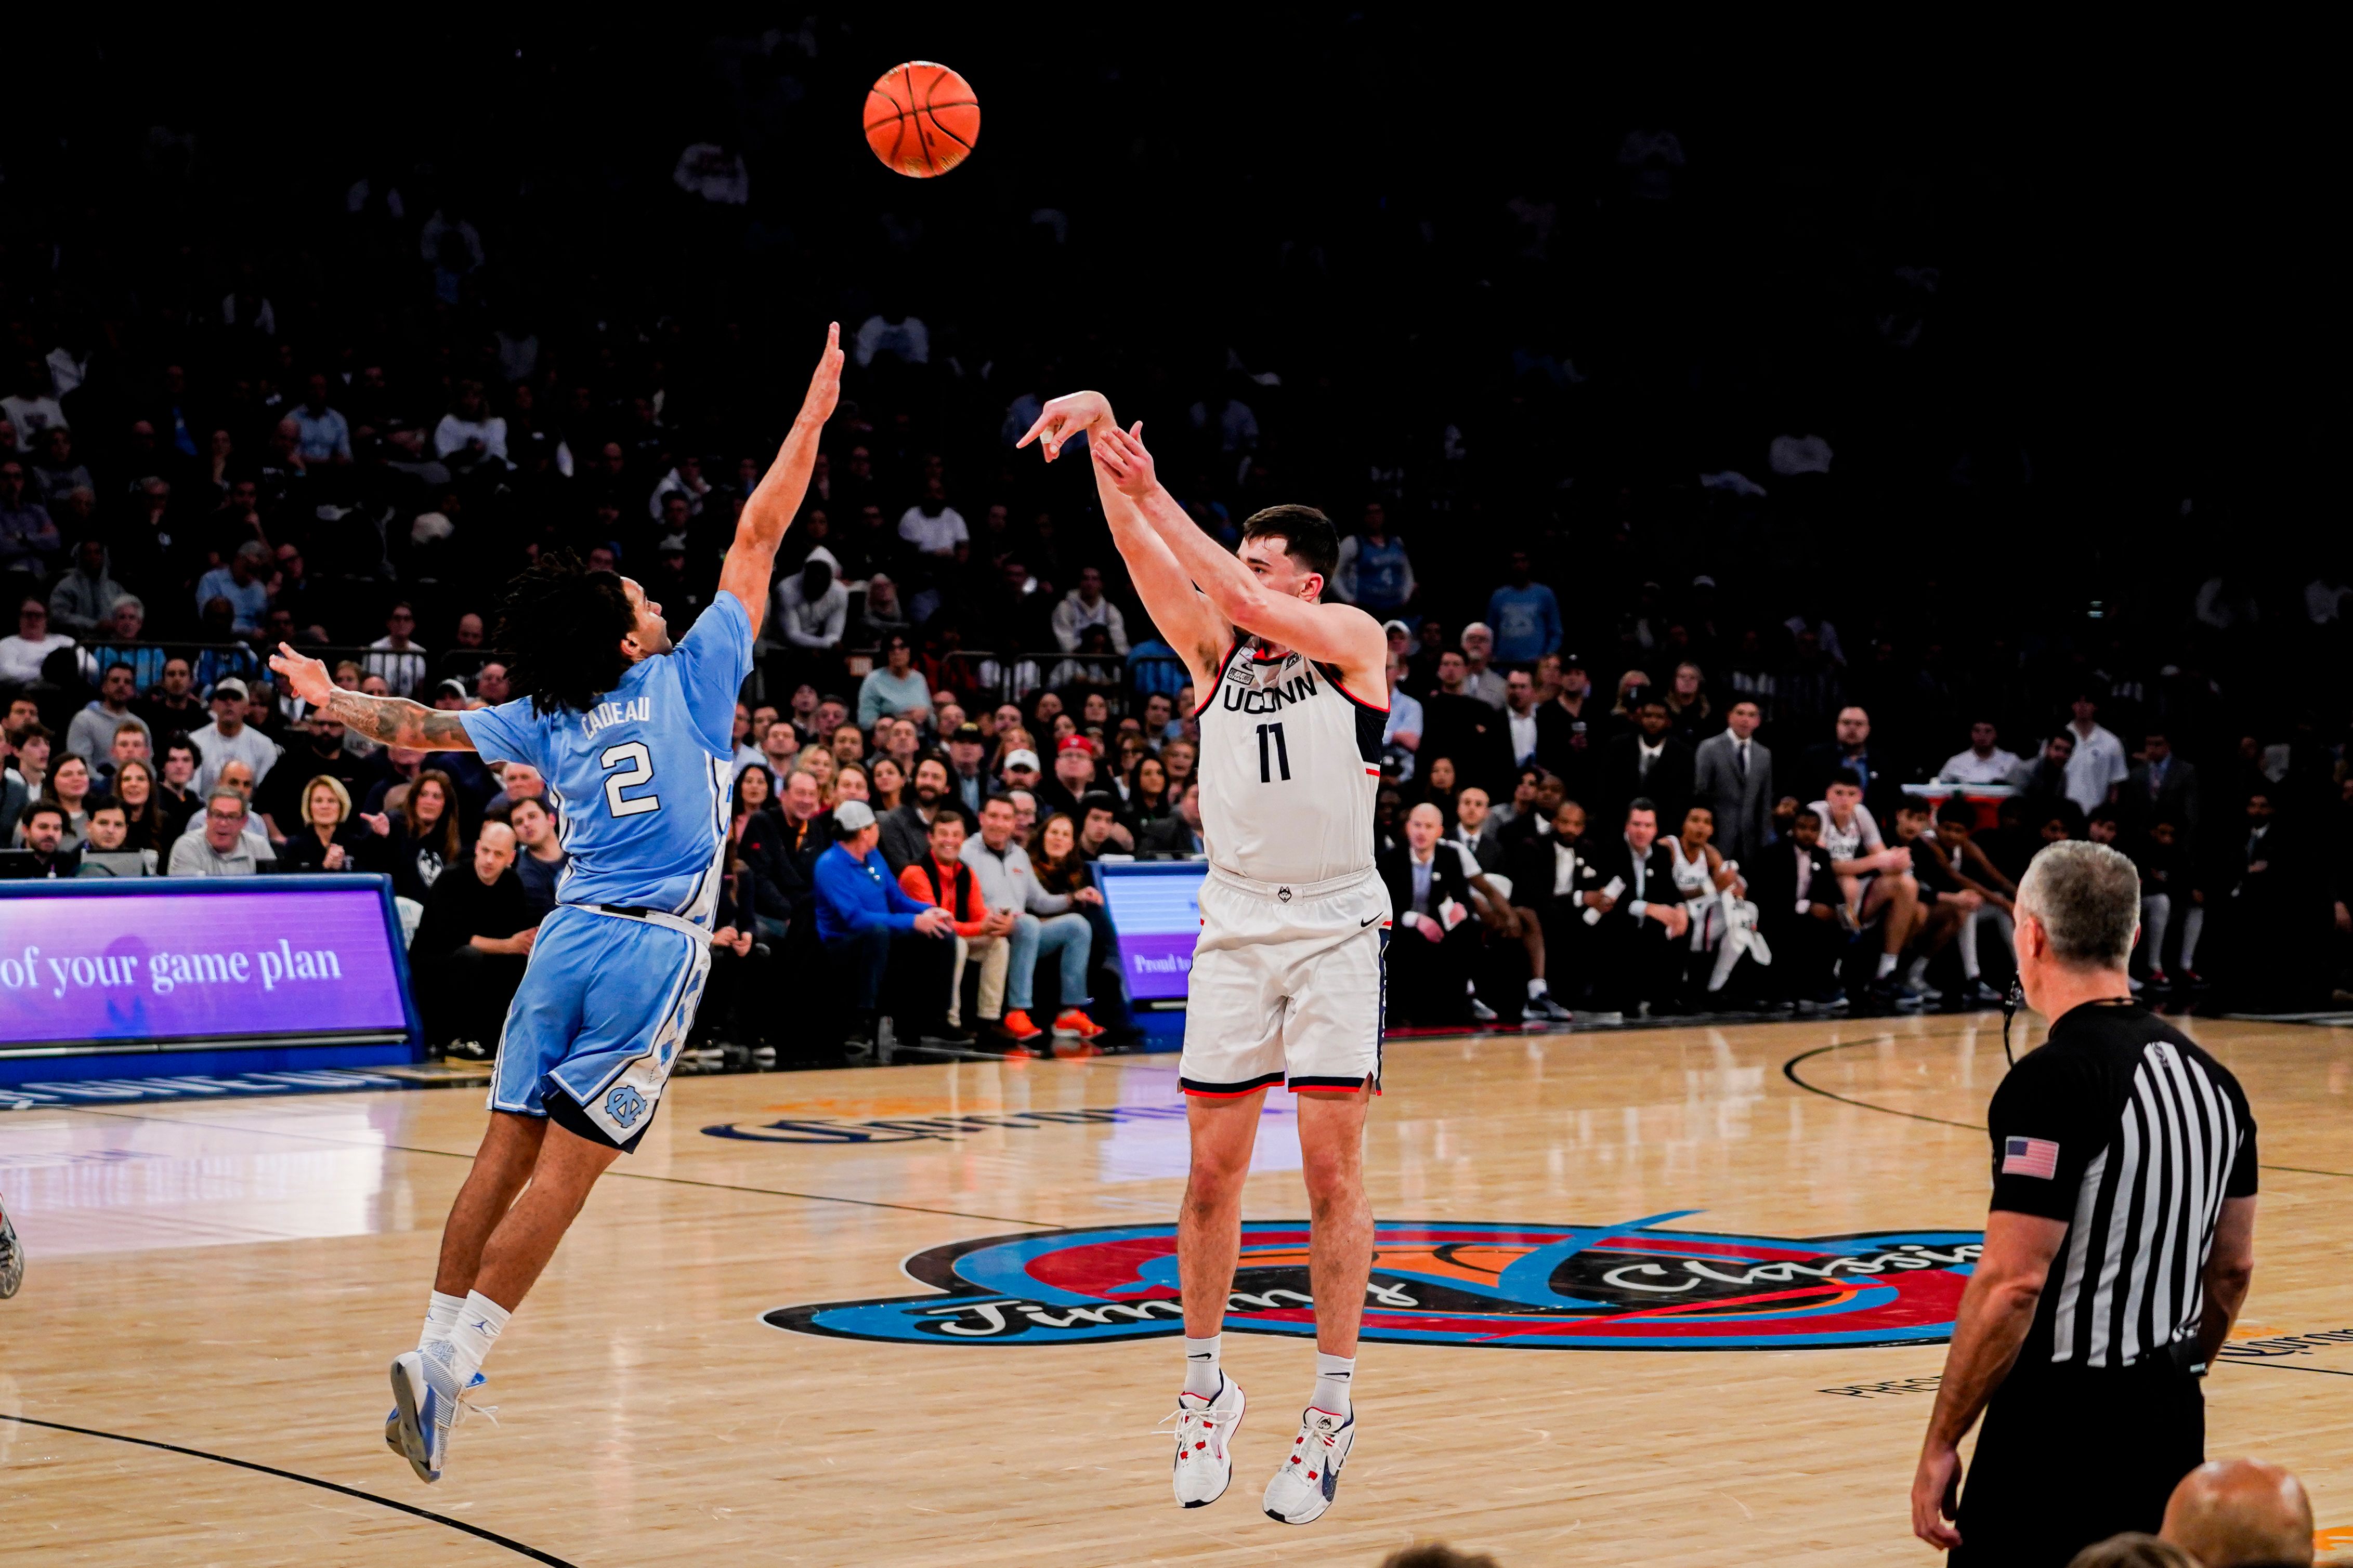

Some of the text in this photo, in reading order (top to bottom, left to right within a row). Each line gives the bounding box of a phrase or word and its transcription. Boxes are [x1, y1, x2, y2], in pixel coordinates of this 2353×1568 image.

[581, 696, 650, 741] CADEAU
[1224, 671, 1318, 714] UCONN
[1256, 722, 1291, 783] 11
[600, 740, 661, 819] 2
[1, 938, 342, 999] of your game plan
[1133, 953, 1177, 973] Proud
